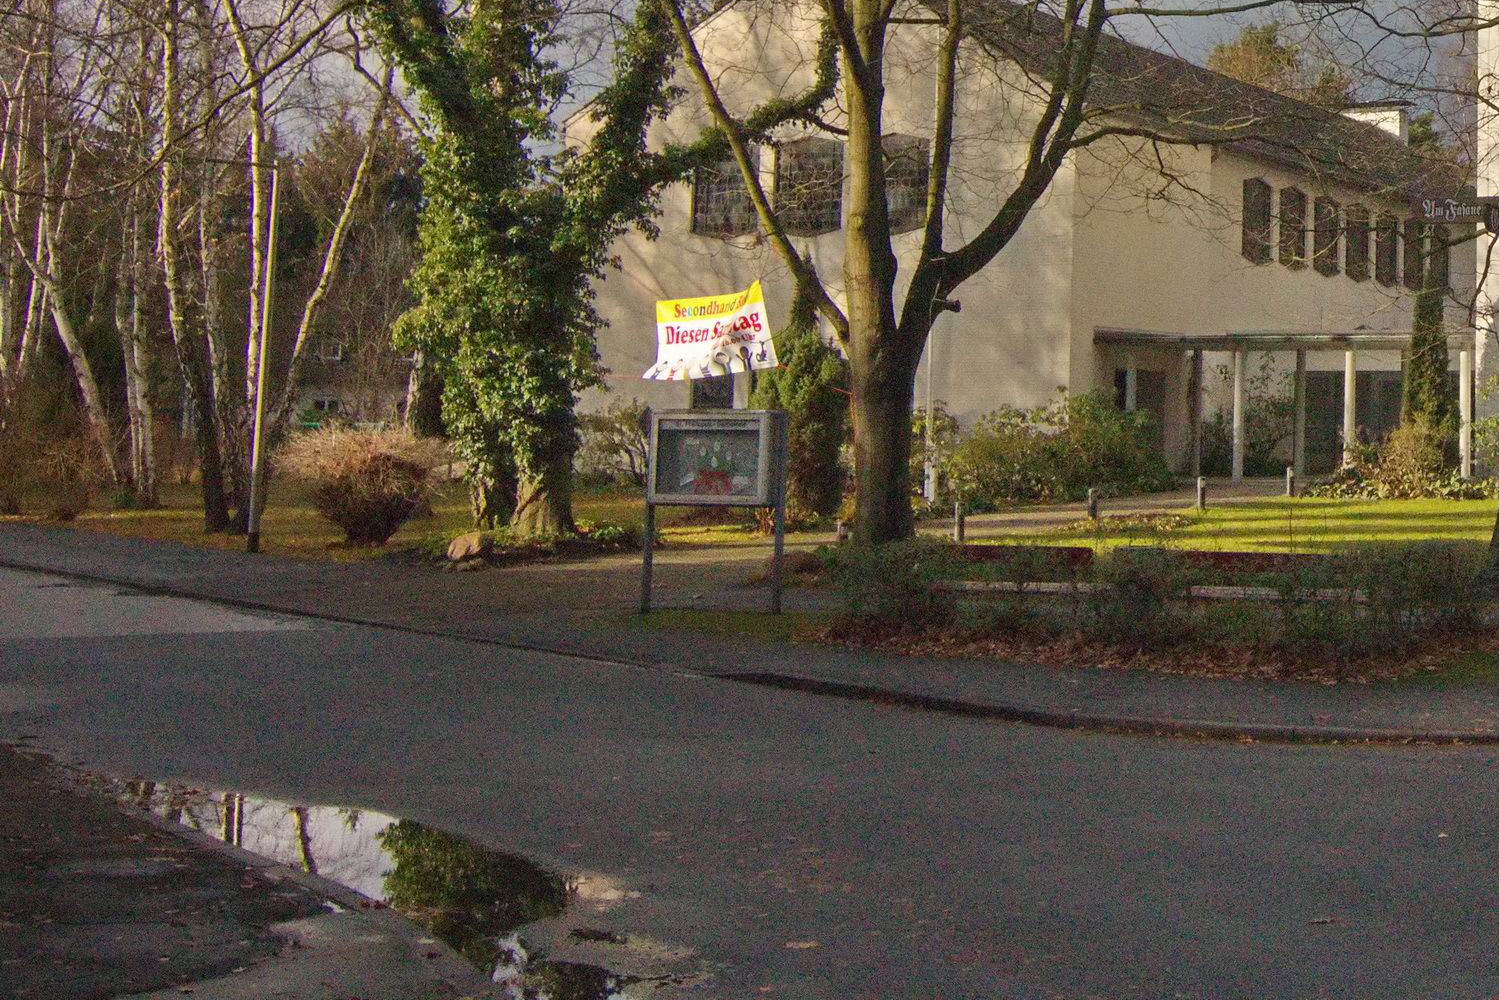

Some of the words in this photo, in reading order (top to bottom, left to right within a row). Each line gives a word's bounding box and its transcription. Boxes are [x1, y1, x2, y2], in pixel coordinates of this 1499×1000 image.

[1422, 199, 1444, 217] Am
[673, 299, 737, 318] Secondhand
[665, 325, 709, 345] Diesen
